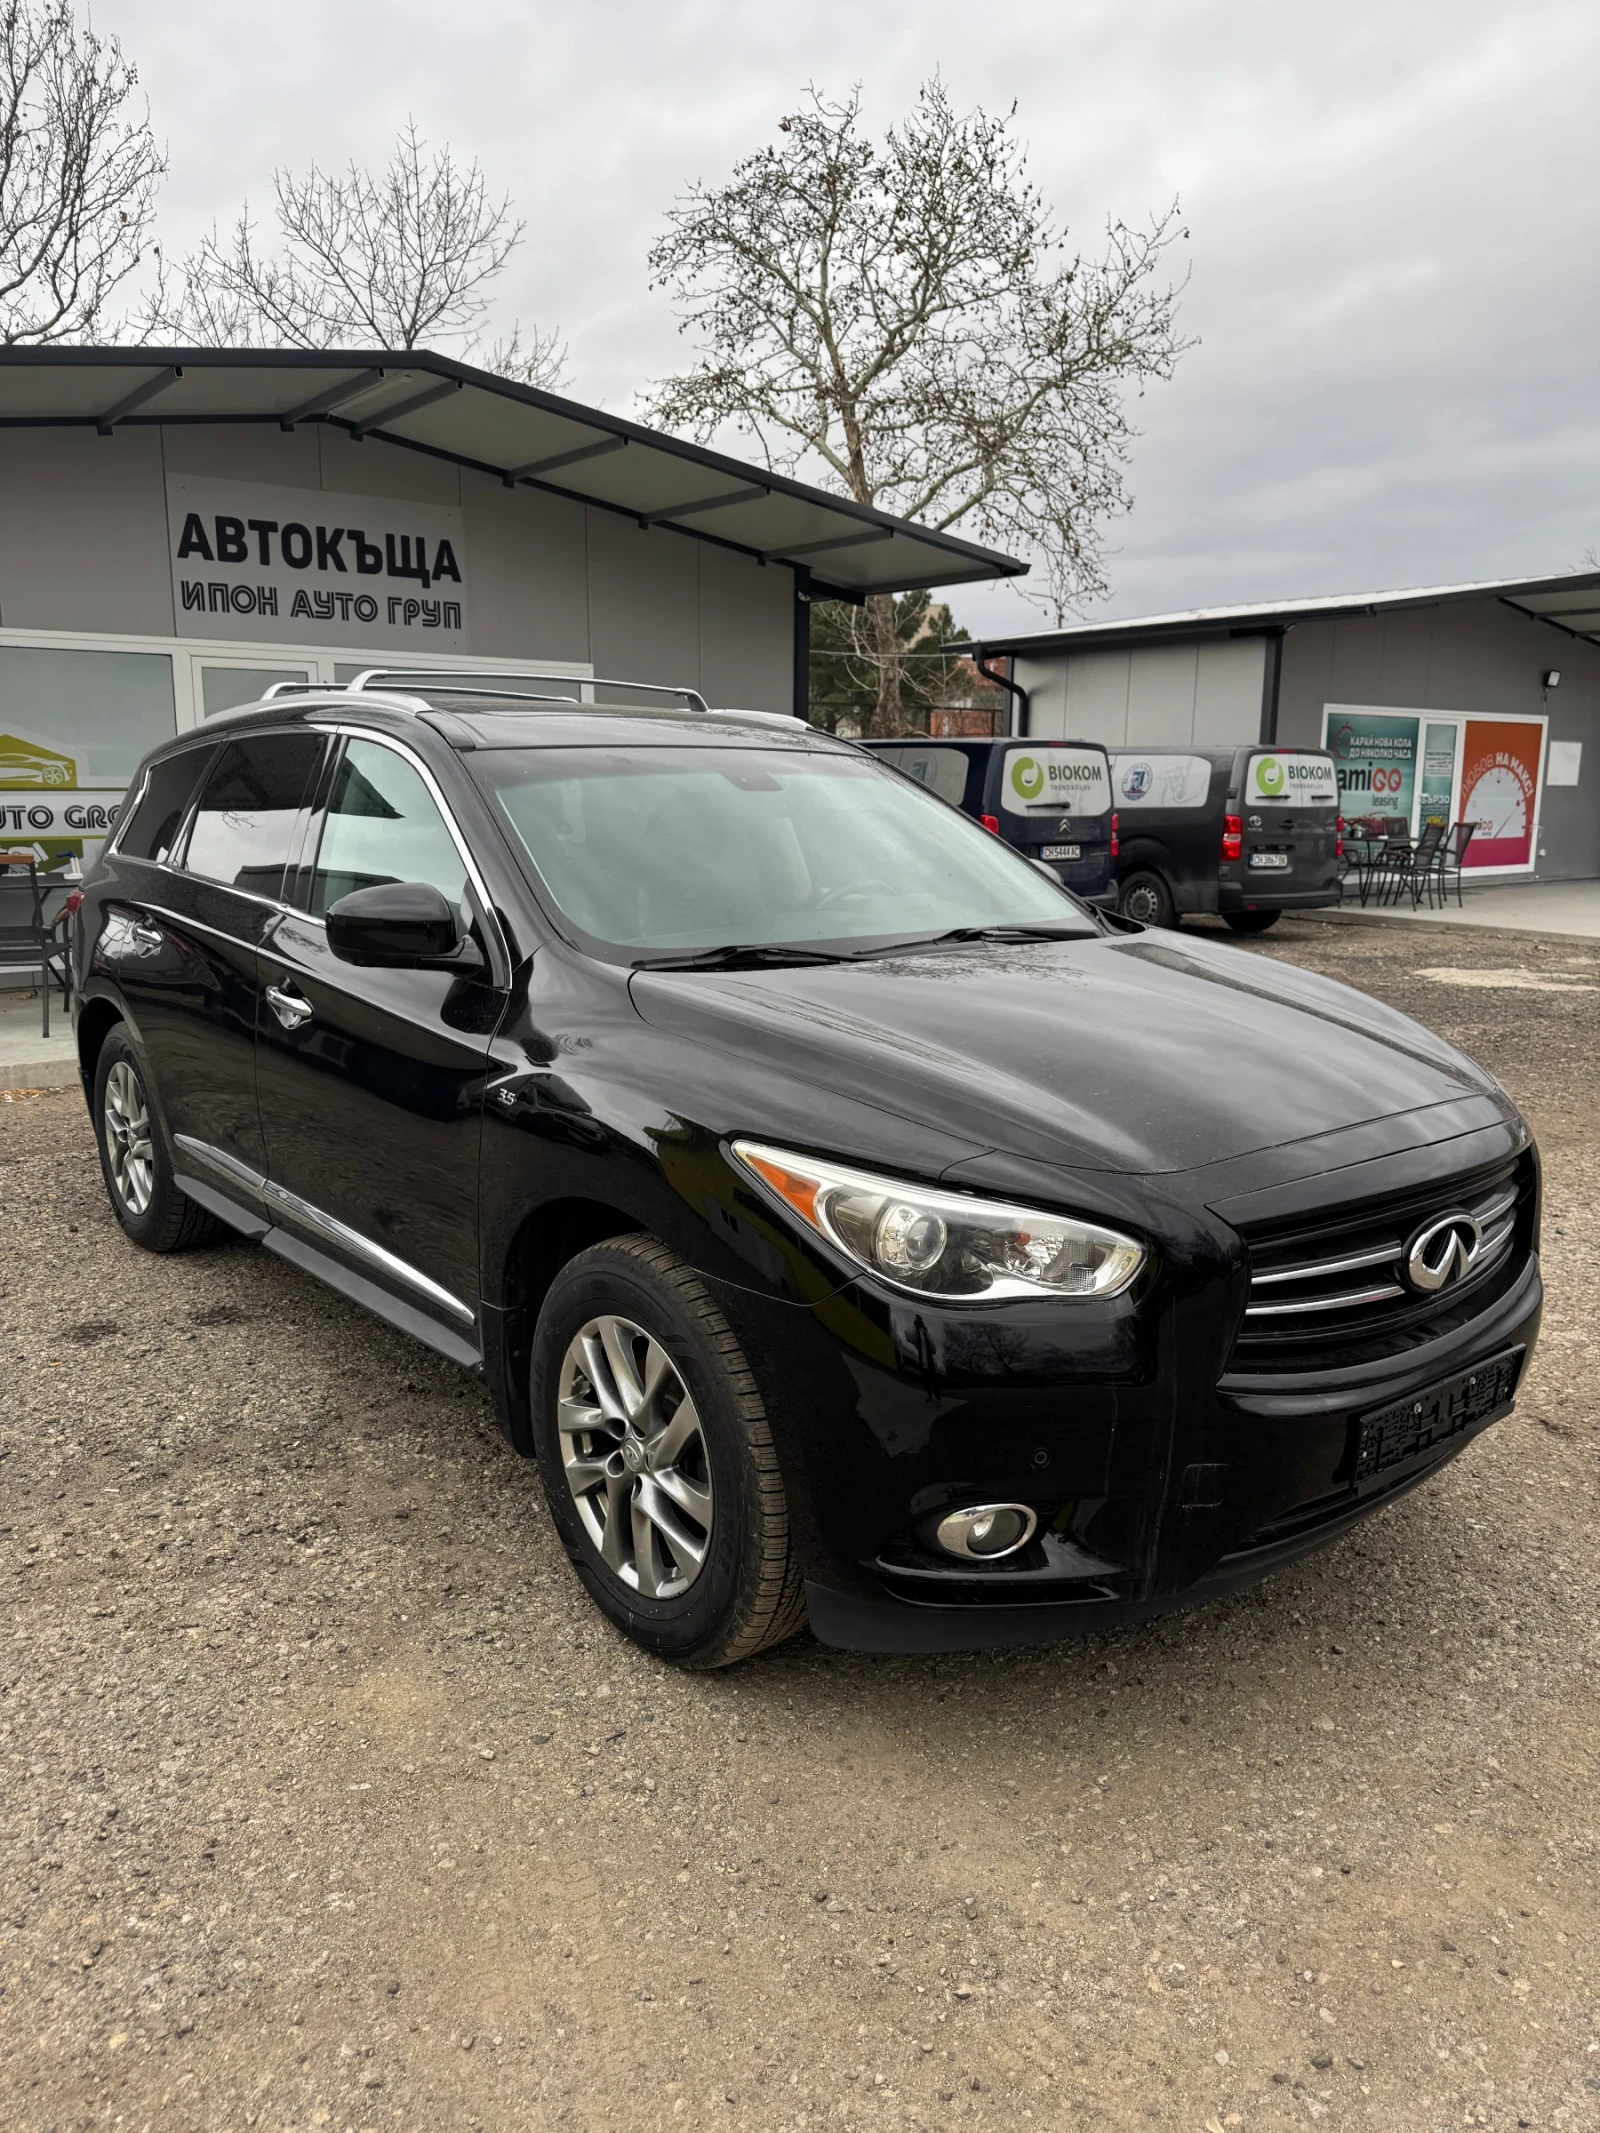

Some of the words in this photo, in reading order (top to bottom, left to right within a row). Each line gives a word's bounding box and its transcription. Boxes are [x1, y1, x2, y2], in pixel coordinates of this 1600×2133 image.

[177, 512, 462, 589] АВТОКЪЩА
[181, 580, 279, 616] ИПОН
[290, 589, 379, 622] АУТО
[387, 596, 462, 630] ГРУП
[1350, 734, 1374, 746] КАРАЙ
[1374, 736, 1393, 747] НОВА
[1393, 738, 1412, 748] КОЛА
[1349, 747, 1360, 758] ДО
[1360, 748, 1393, 758] НЯКОЛКО
[1393, 749, 1411, 759] ЧАСА
[1495, 751, 1510, 766] НА
[1048, 765, 1102, 781] BIOKOM
[1288, 765, 1333, 780] BIOKOM
[1371, 794, 1399, 810] leasing
